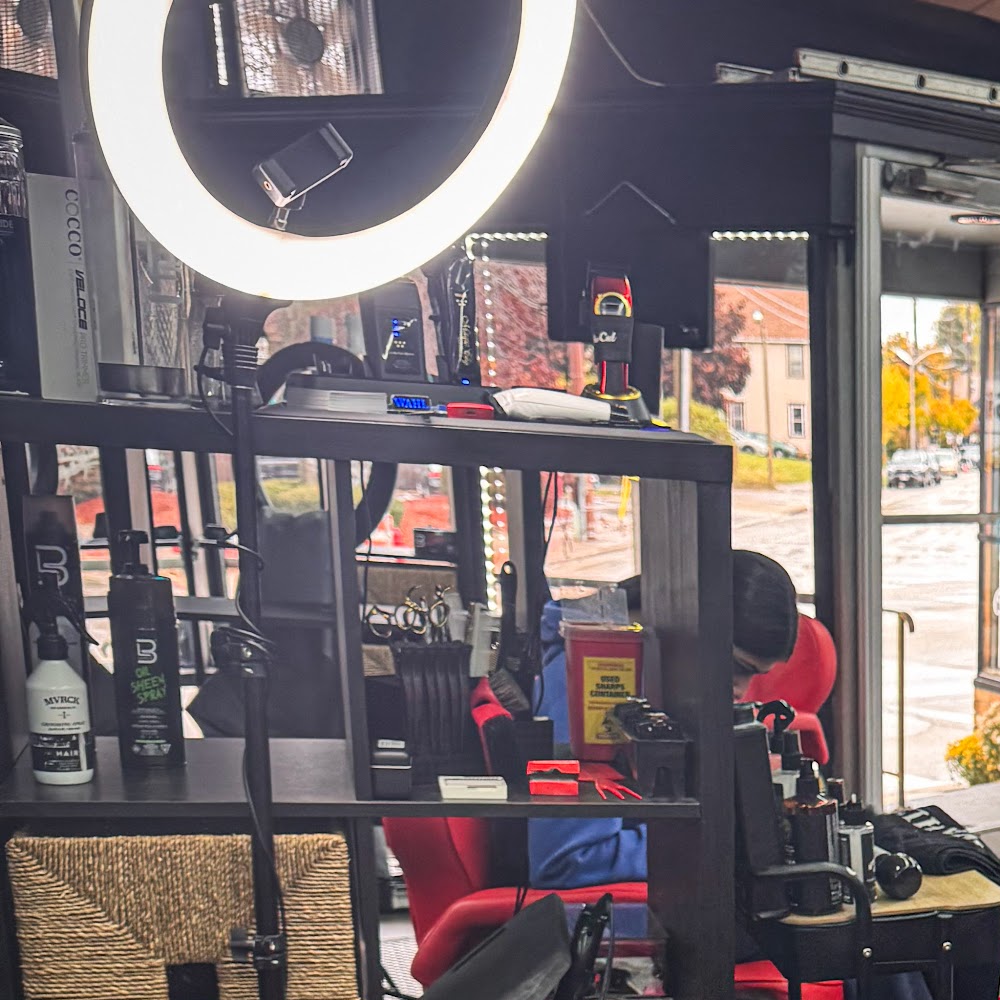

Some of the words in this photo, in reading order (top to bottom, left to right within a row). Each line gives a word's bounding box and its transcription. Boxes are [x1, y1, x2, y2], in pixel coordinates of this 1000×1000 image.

[65, 189, 82, 256] COCCO
[75, 269, 88, 331] VELOCE
[392, 397, 430, 410] WAHL
[44, 696, 80, 706] MVRCK
